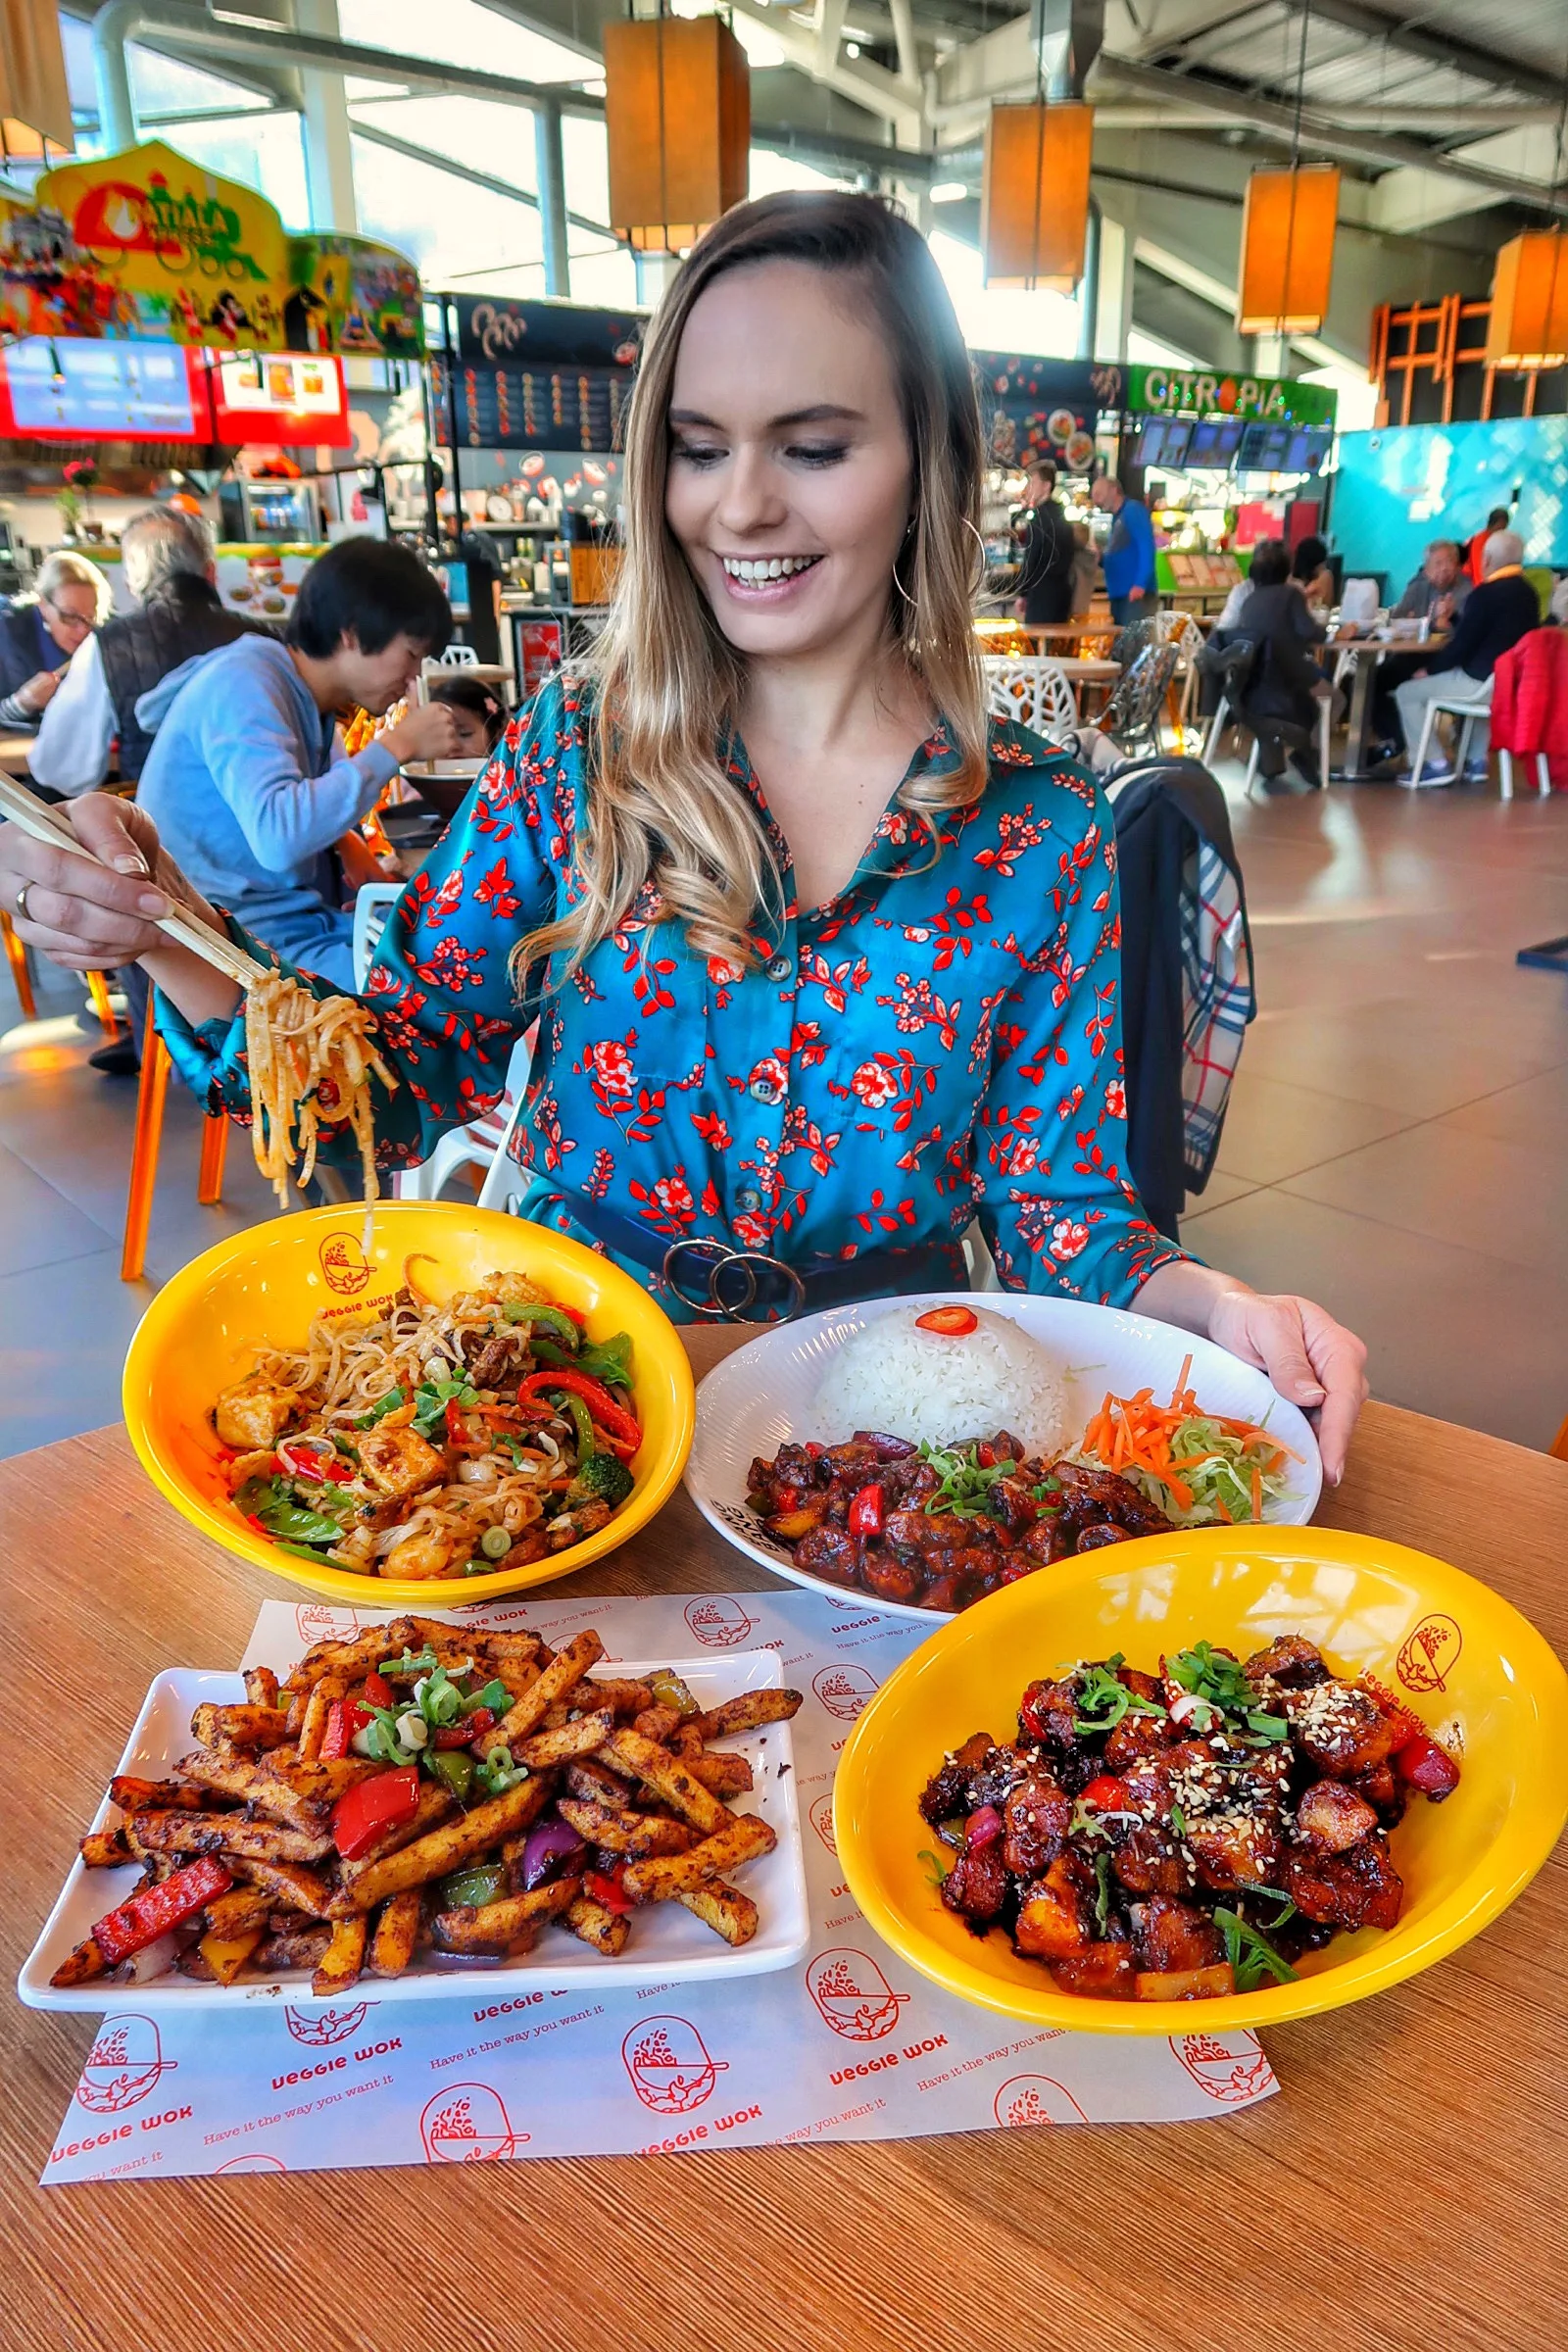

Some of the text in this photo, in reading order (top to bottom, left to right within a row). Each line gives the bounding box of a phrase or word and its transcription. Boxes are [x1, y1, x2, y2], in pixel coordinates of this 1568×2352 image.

[541, 1620, 560, 1629] way
[562, 1614, 578, 1624] you
[580, 1607, 603, 1618] want
[836, 1639, 859, 1649] Have
[906, 1624, 921, 1633] you
[808, 1773, 826, 1782] way
[824, 1915, 854, 1929] Have
[636, 1984, 667, 1999] Have
[430, 2005, 605, 2069] Have it the way you want it
[917, 2029, 1065, 2091] Have it the way you want
[204, 2075, 394, 2145] Have it the way you want it
[786, 2126, 811, 2141] way
[814, 2115, 839, 2132] you
[840, 2102, 873, 2121] want
[874, 2097, 886, 2109] it
[110, 2157, 148, 2175] want
[151, 2151, 163, 2162] it
